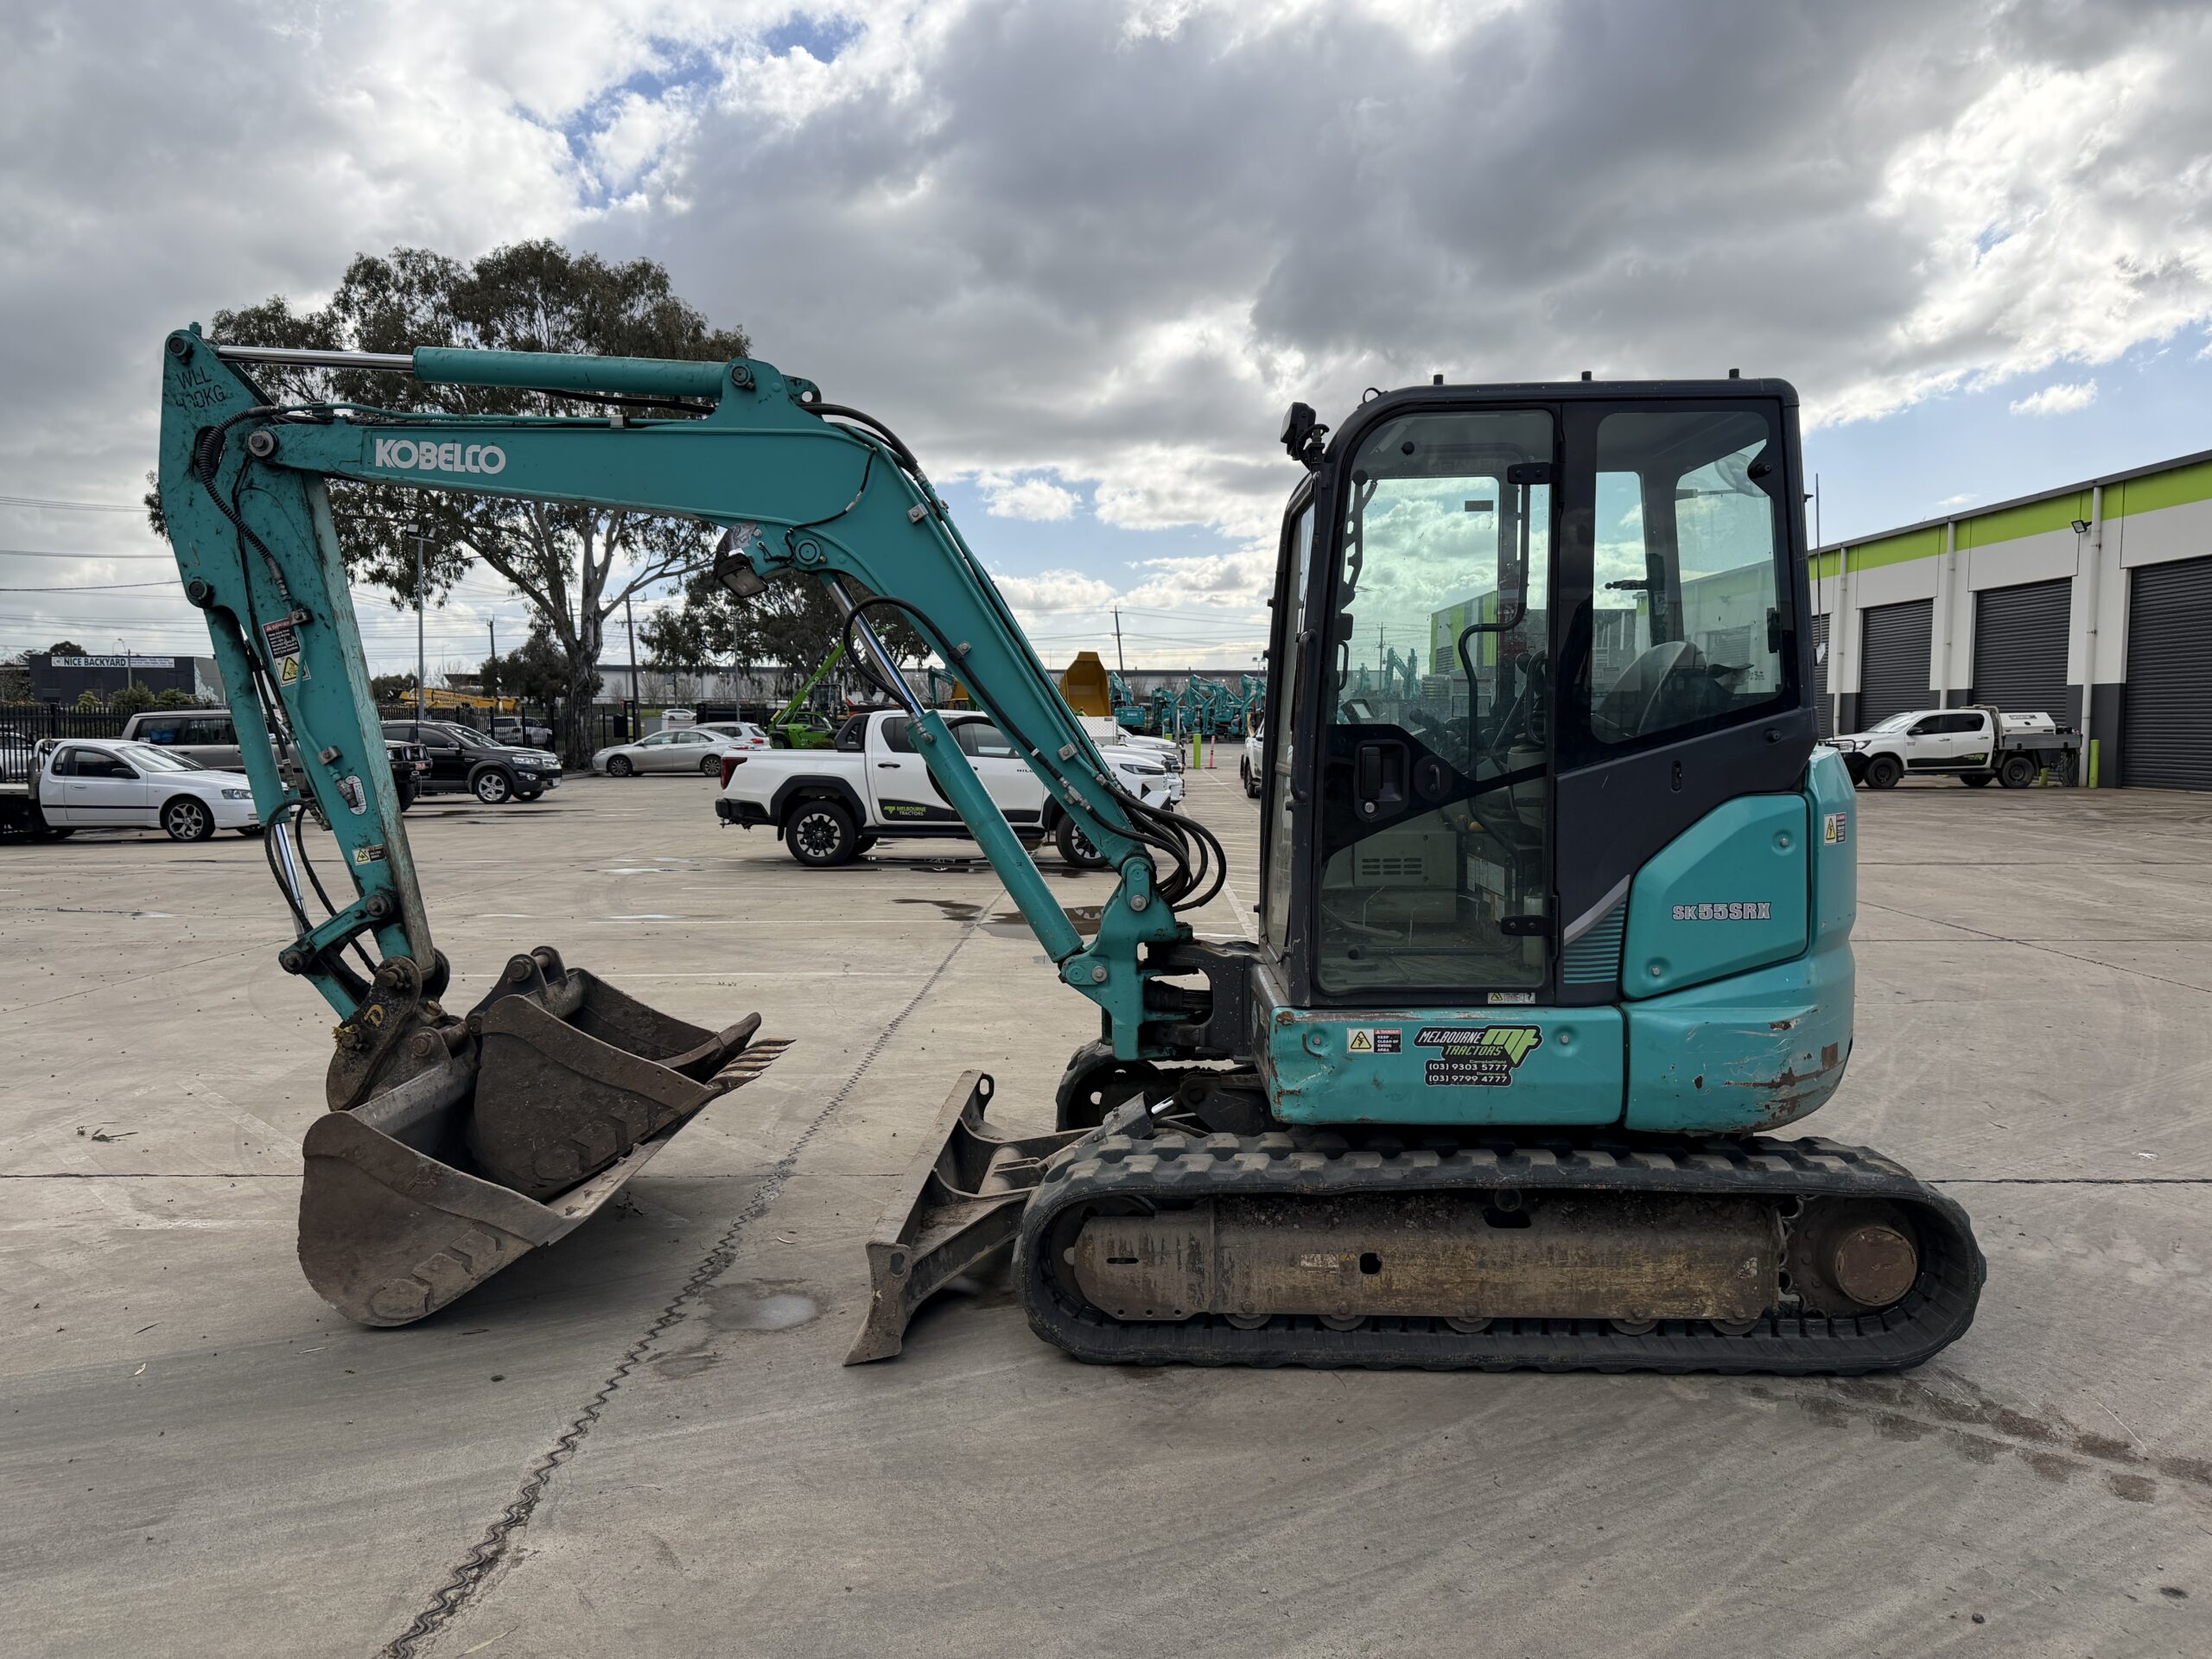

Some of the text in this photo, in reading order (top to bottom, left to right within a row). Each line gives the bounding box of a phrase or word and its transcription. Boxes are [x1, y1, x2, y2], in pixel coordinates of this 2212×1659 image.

[176, 366, 212, 389] WLL
[376, 439, 506, 474] KOBELCO
[64, 658, 81, 666] NICE
[84, 658, 126, 666] BACKYARD
[1672, 902, 1771, 920] SK55SRX
[1418, 1031, 1484, 1044] MELBOURNE
[1445, 1046, 1503, 1056] TRACTORS
